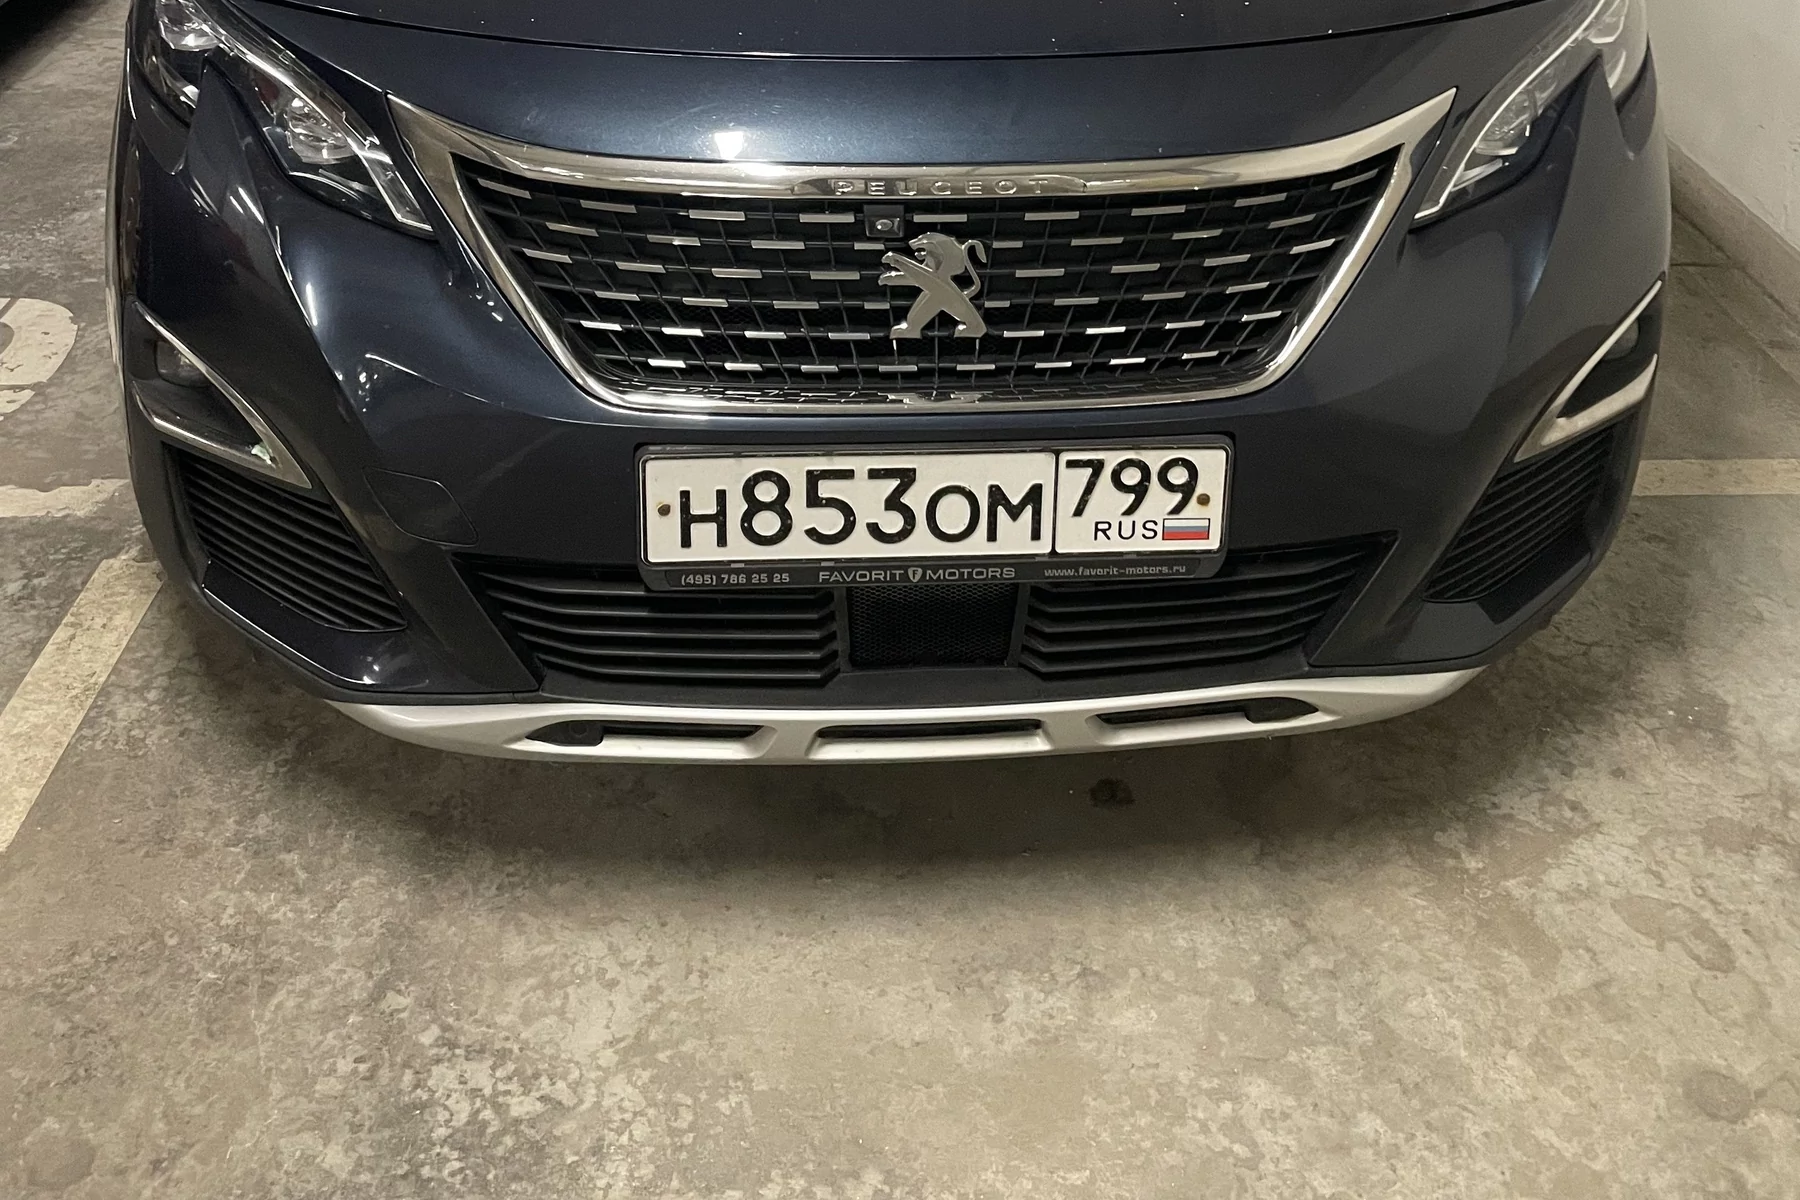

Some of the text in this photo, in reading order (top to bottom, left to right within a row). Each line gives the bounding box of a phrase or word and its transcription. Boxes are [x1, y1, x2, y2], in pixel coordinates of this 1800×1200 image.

[1065, 457, 1199, 517] 799
[1093, 519, 1158, 541] RUS
[818, 570, 904, 583] FAVORIT
[925, 567, 1016, 580] MOTORS
[1044, 565, 1187, 577] www.favorit-motors.ru
[681, 573, 790, 586] (495) 786 25 25
